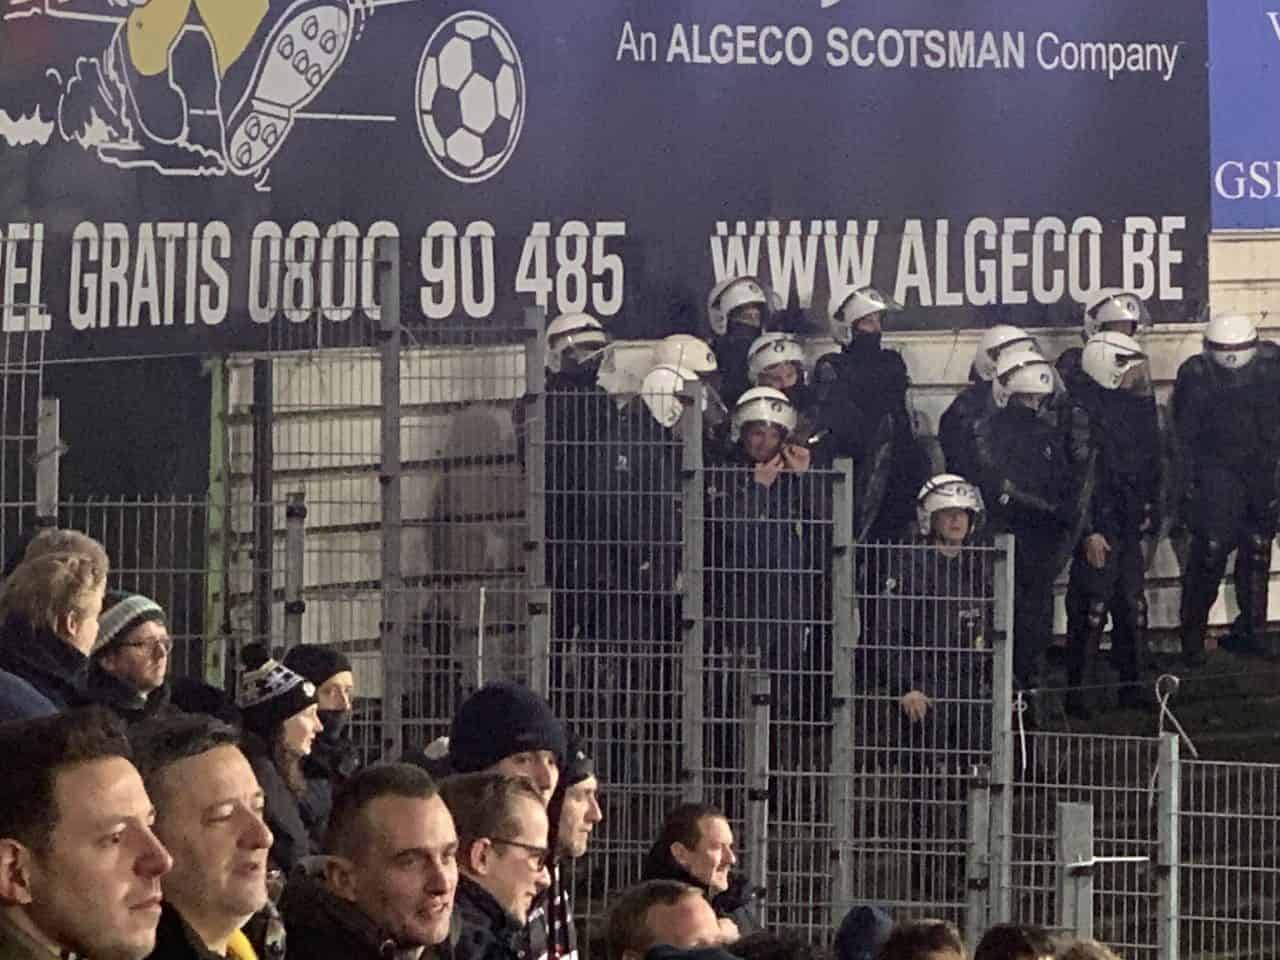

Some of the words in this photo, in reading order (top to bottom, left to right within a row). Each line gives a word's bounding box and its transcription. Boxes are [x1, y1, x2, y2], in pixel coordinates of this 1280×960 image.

[616, 21, 657, 63] An
[666, 23, 814, 66] ALGECO
[826, 27, 1025, 70] SCOTSMAN
[1036, 31, 1179, 81] Company
[0, 222, 52, 332] EL
[68, 220, 230, 332] GRATIS
[420, 220, 496, 320] 90
[515, 220, 627, 317] 485
